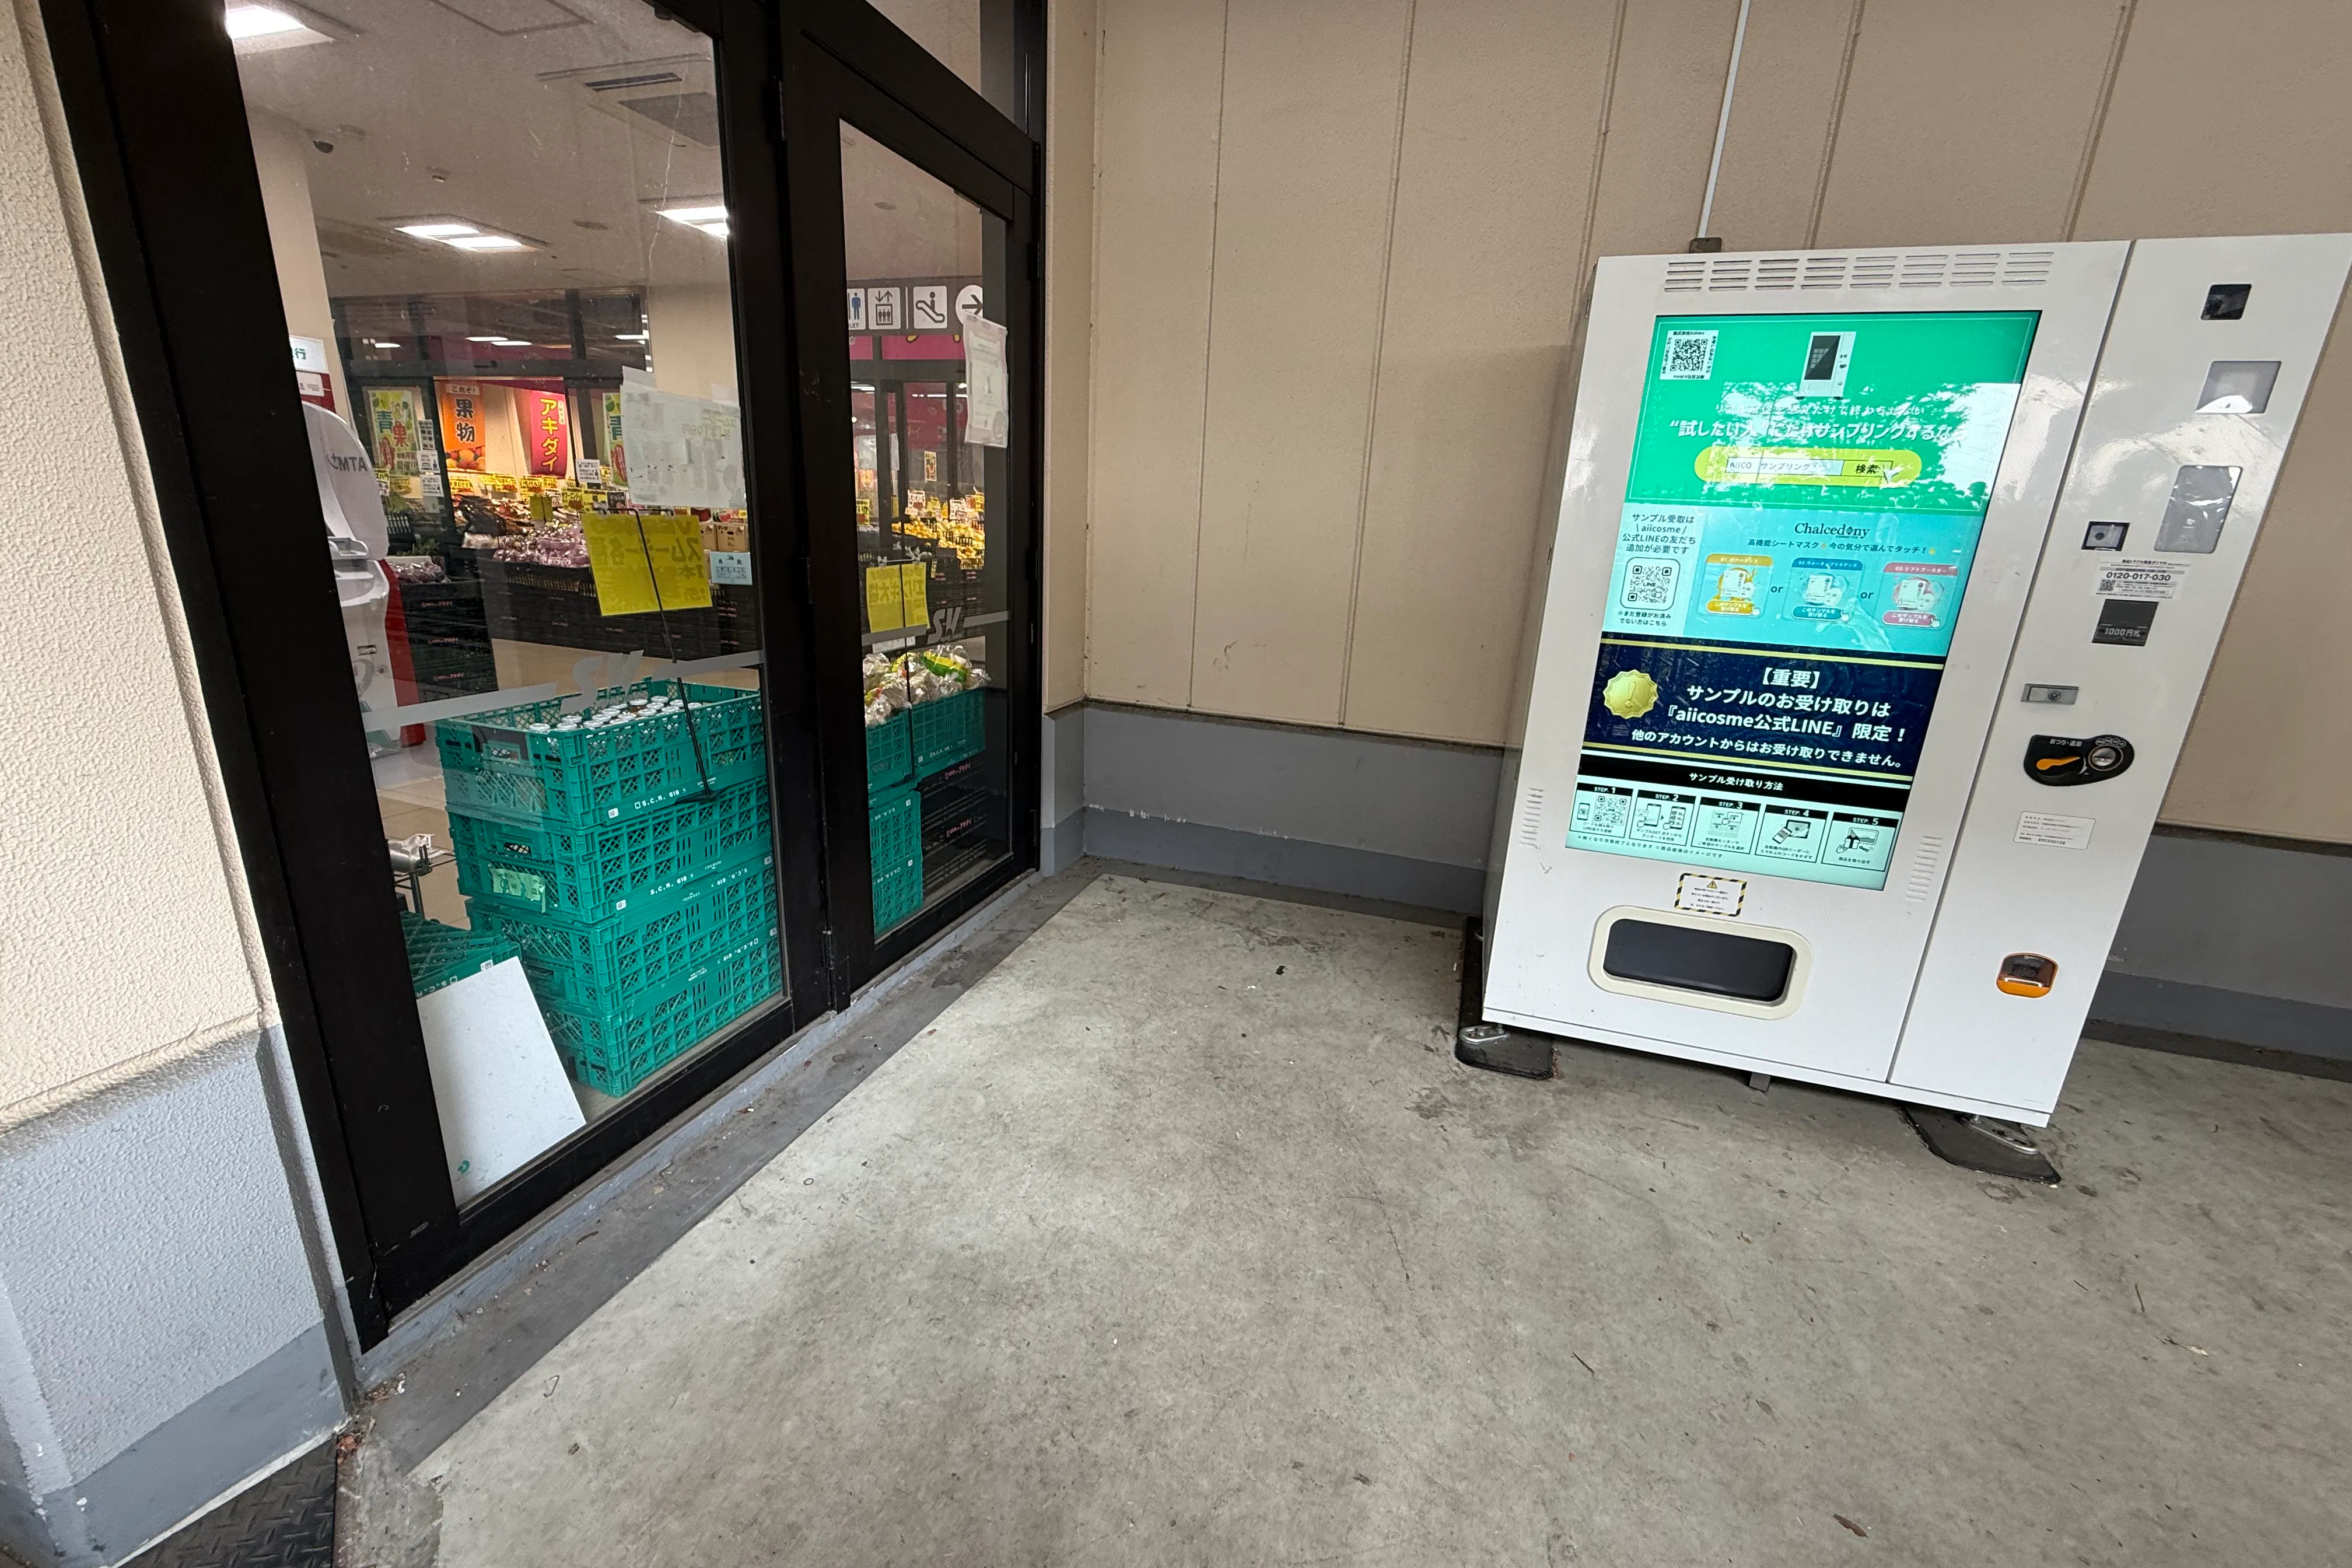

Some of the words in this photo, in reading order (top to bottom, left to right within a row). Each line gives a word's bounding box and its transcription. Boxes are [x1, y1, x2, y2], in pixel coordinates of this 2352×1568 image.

[294, 347, 306, 360] 行
[455, 398, 475, 443] 果物
[376, 410, 408, 447] 青果
[540, 398, 560, 473] アキダイ
[1760, 463, 1812, 471] サンプリング
[1855, 464, 1879, 474] 検索
[1632, 513, 1695, 524] サンプル受取は
[1642, 525, 1681, 534] aiicosme
[1622, 533, 1696, 545] 公式LINEの友だち
[1748, 538, 1819, 549] 高機能シートマスク
[1626, 543, 1689, 554] 追加が必要です
[2106, 572, 2171, 581] 0120-017-030
[1770, 585, 1784, 593] or
[1619, 618, 1668, 627] でない方はこちら
[2104, 628, 2141, 637] 1000円札
[1762, 667, 1820, 690] 【重要】
[1686, 685, 1892, 718] サンプルのお受け取りは
[1631, 729, 1902, 769] 他のアカウントからはお受け取りできません。
[1689, 772, 1784, 792] サンプル受け取り方法
[1871, 817, 1880, 825] 5
